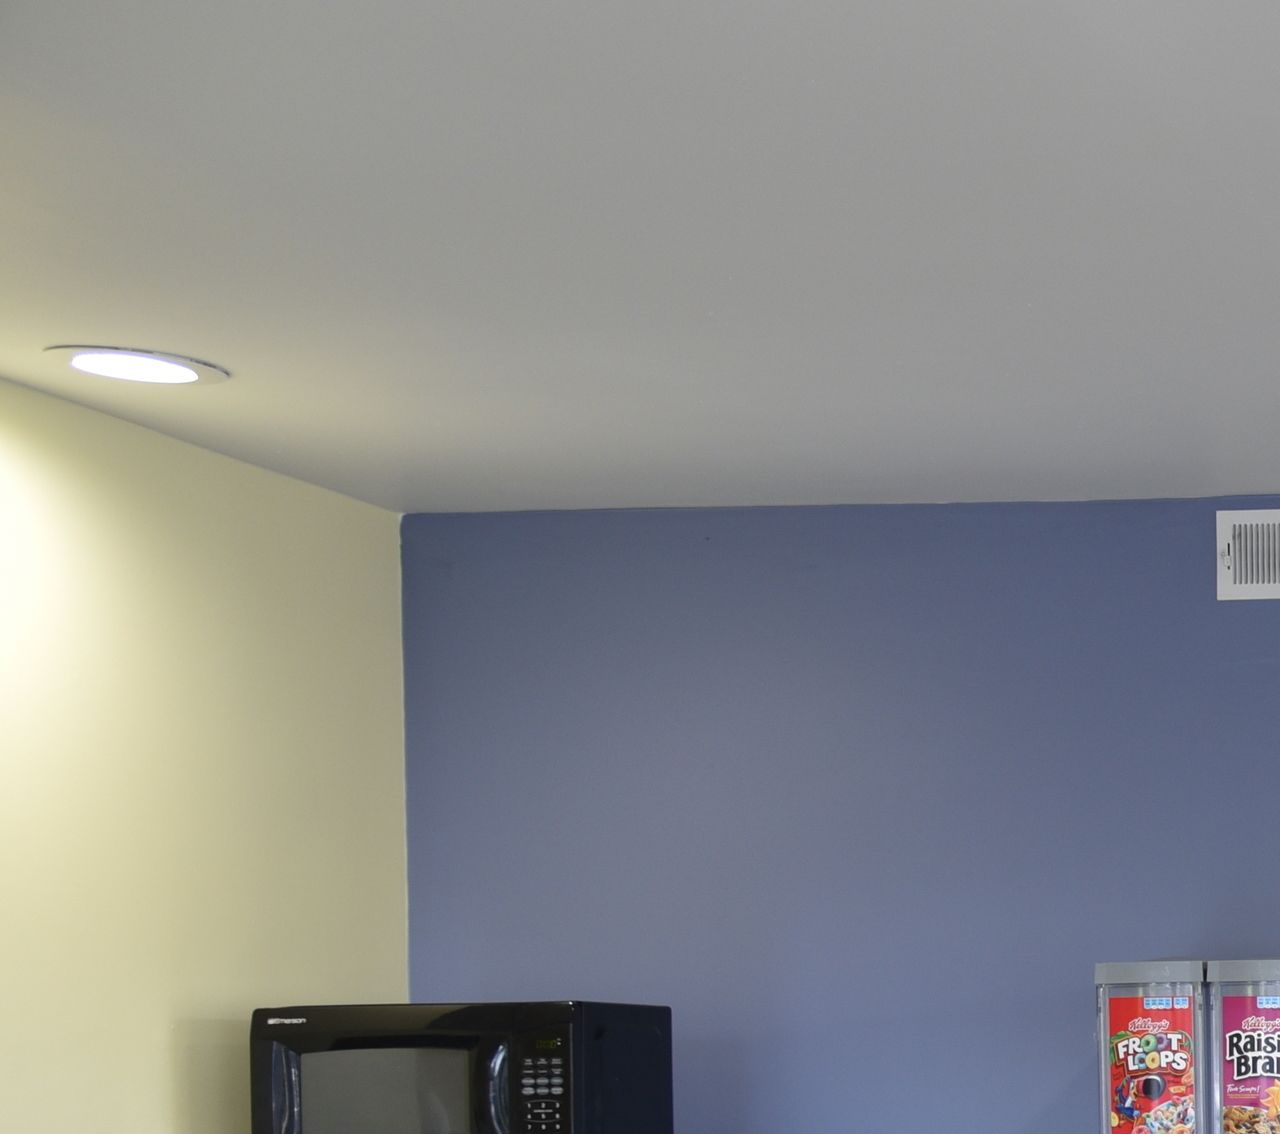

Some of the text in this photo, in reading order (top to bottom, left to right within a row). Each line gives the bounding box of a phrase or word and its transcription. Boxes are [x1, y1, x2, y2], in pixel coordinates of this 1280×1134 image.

[1128, 1017, 1169, 1033] Kellogg's
[1117, 1033, 1182, 1060] FROOT
[1127, 1050, 1188, 1071] LOOPS
